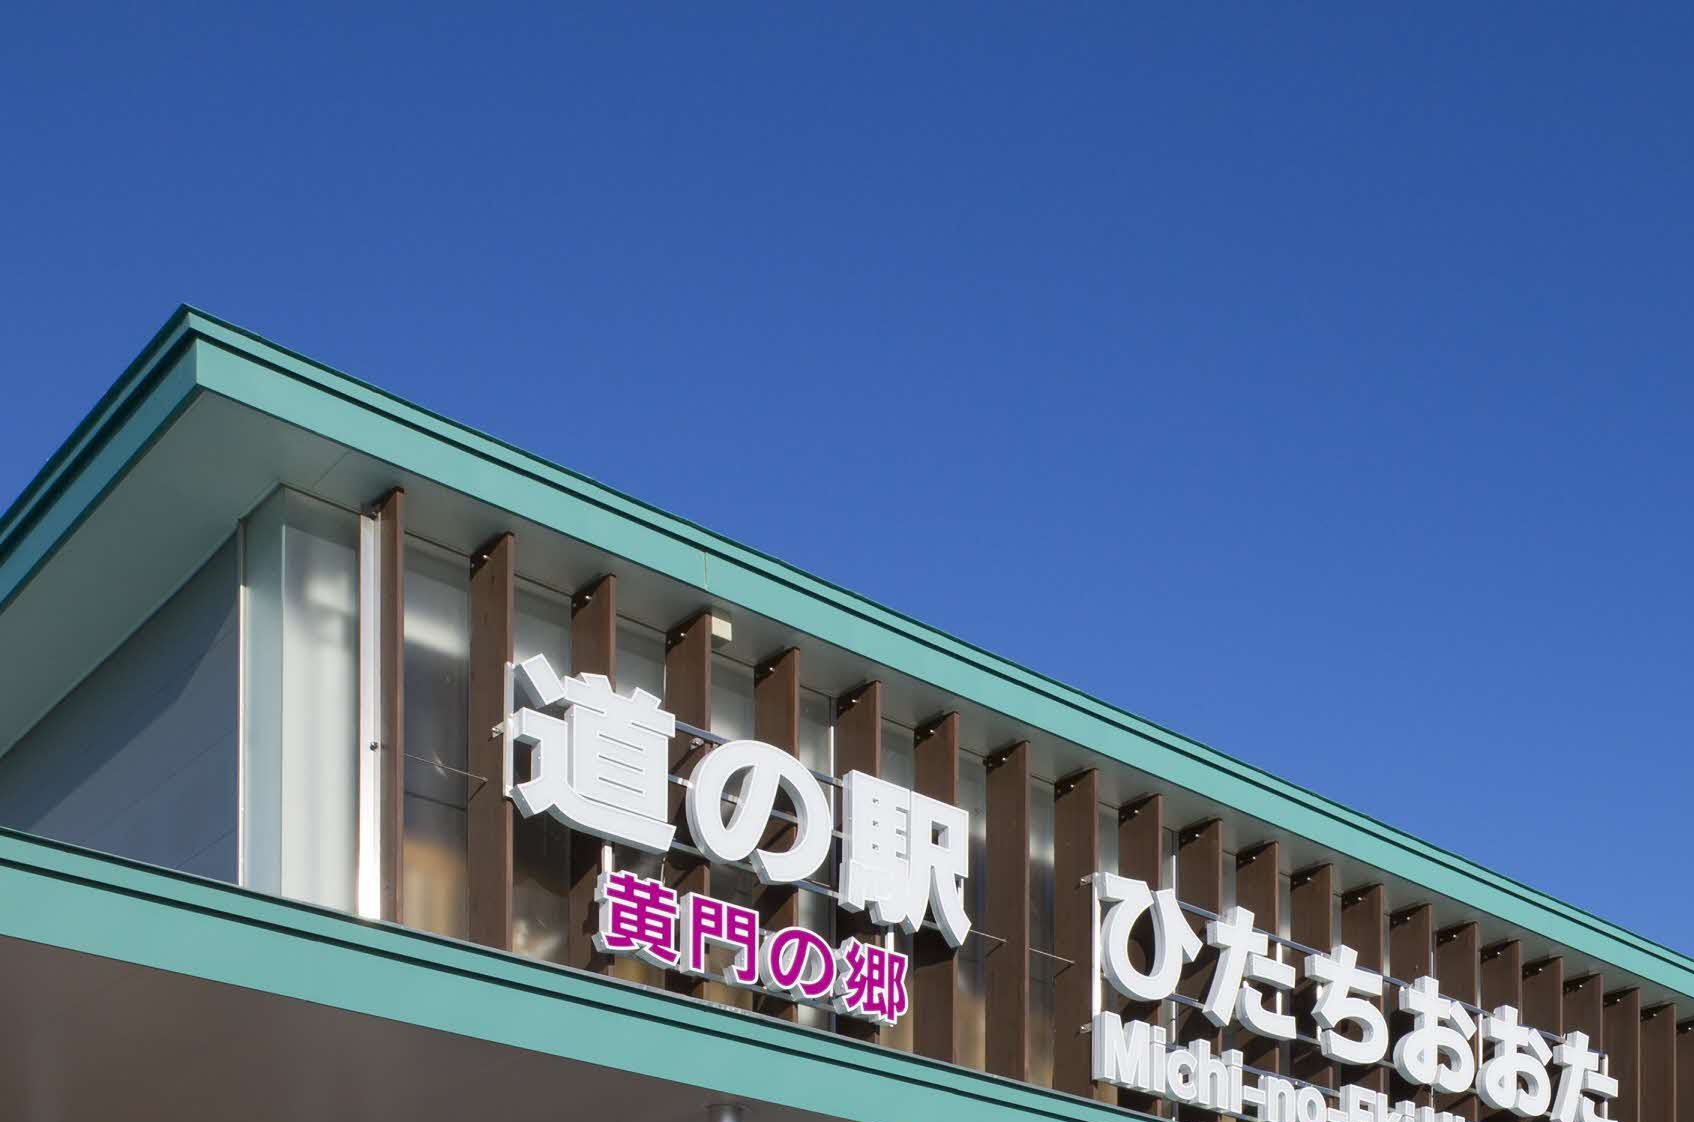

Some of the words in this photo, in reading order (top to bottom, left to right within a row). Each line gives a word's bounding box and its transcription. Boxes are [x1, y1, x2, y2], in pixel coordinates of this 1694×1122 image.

[505, 653, 972, 948] 道の駅
[592, 870, 909, 1027] 黄門の郷
